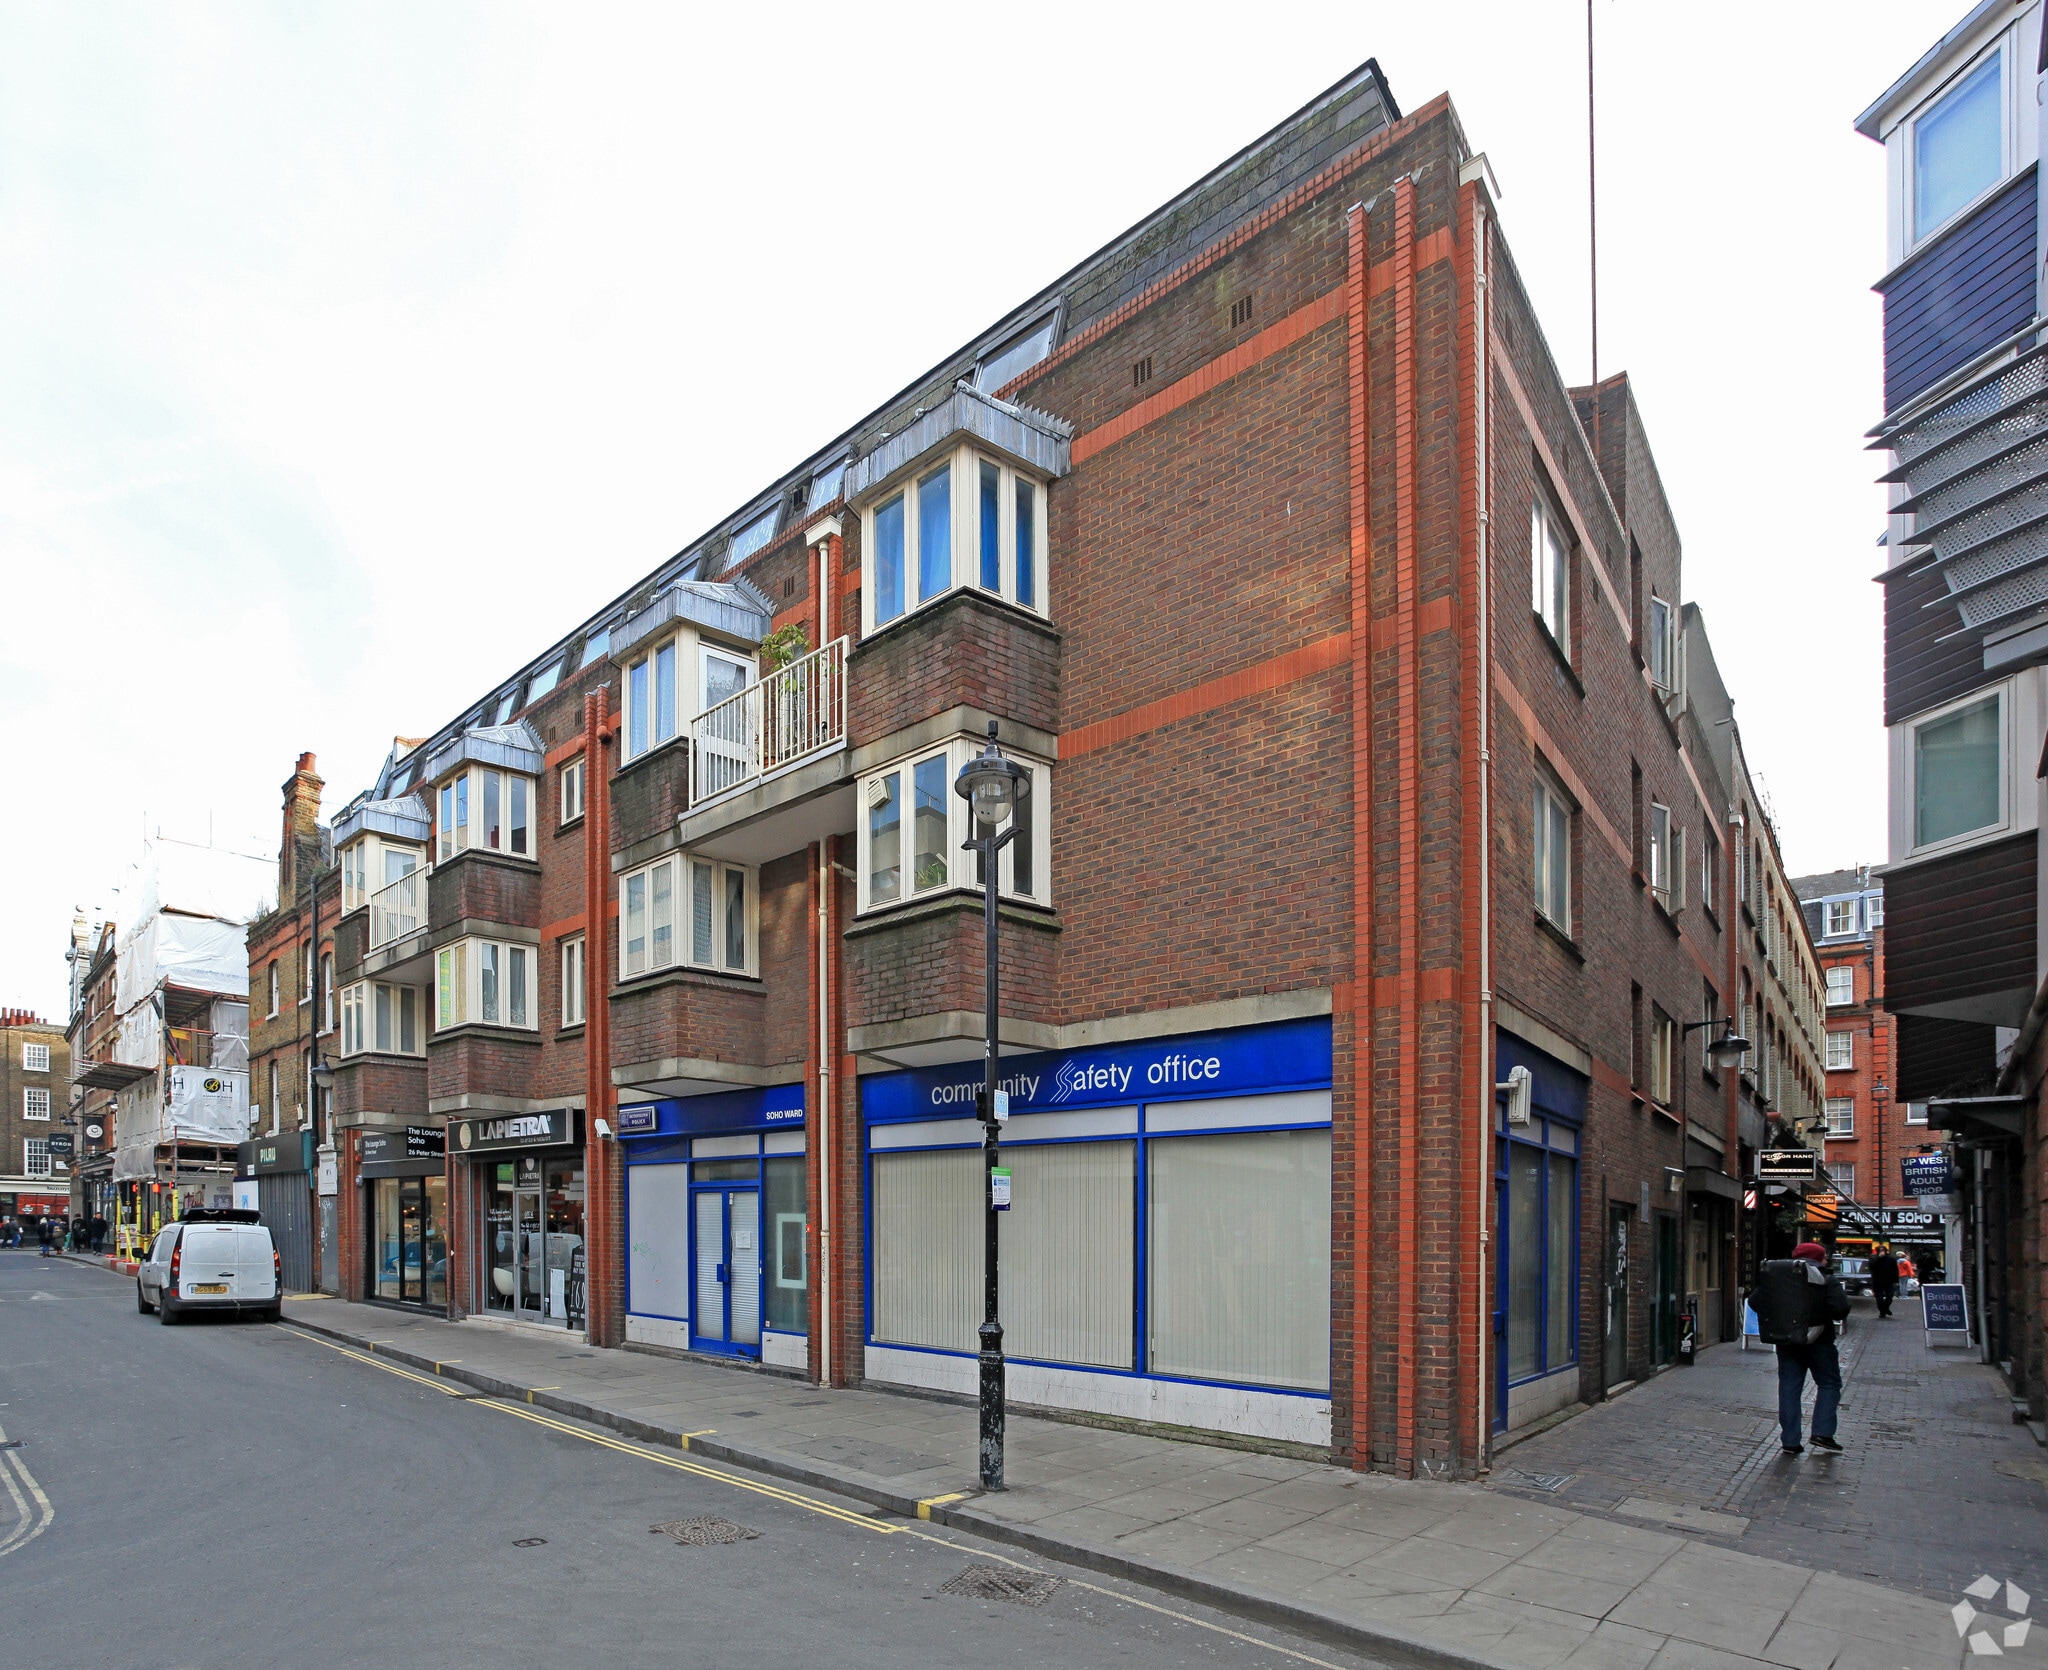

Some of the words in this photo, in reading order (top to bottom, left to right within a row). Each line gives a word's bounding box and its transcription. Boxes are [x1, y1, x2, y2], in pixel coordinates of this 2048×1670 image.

[985, 1040, 991, 1048] 4
[985, 1050, 991, 1058] A
[931, 1073, 1040, 1105] commnity
[1147, 1055, 1220, 1084] office
[766, 1111, 783, 1120] SOHO
[784, 1109, 803, 1118] WARD
[408, 1127, 420, 1135] The
[421, 1128, 446, 1138] Lounge
[407, 1136, 425, 1144] Soho
[416, 1149, 430, 1157] Peter
[1901, 1158, 1917, 1166] UP
[1918, 1156, 1950, 1165] WEST
[1905, 1166, 1948, 1176] BRITISH
[1909, 1176, 1944, 1186] ADULT
[1912, 1186, 1943, 1195] SHOP
[1897, 1211, 1933, 1224] SOHO
[1926, 1292, 1960, 1301] British
[1930, 1303, 1959, 1311] Adult
[1930, 1313, 1960, 1322] Shop
